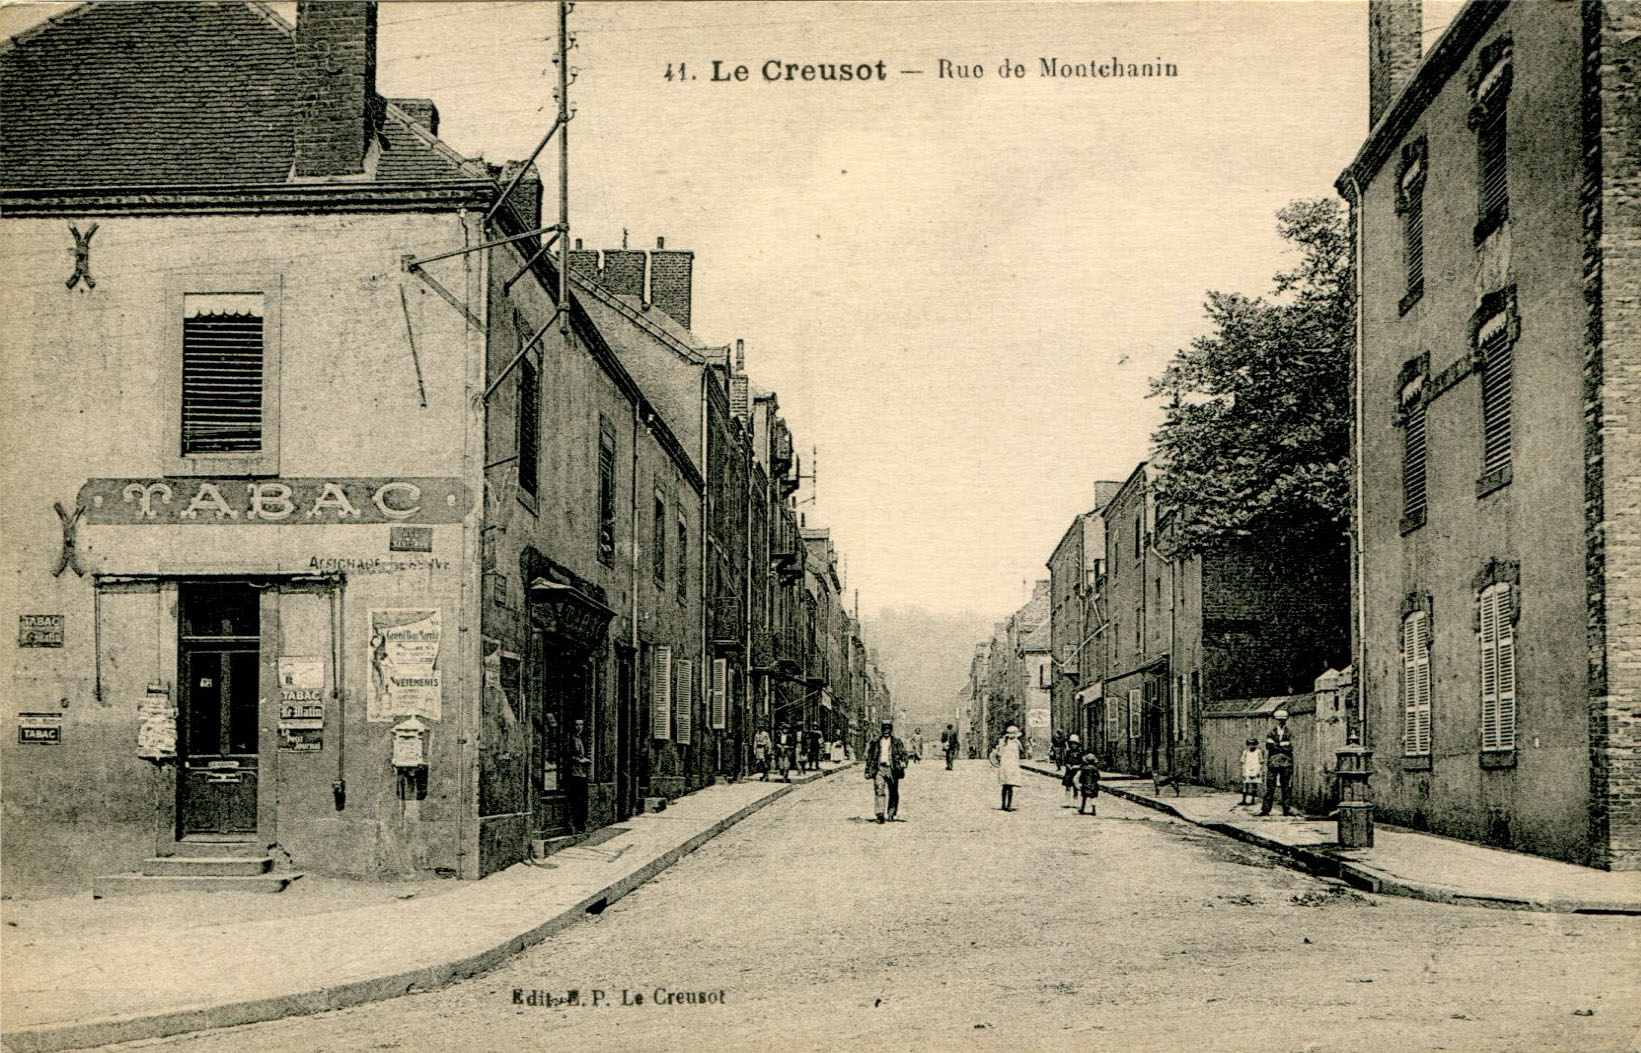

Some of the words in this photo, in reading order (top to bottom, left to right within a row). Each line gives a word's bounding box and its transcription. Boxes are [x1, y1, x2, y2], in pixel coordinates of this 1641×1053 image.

[122, 481, 421, 521] TABAC
[21, 617, 61, 627] TABAC
[282, 690, 321, 701] TABAC
[23, 729, 57, 739] TABAC
